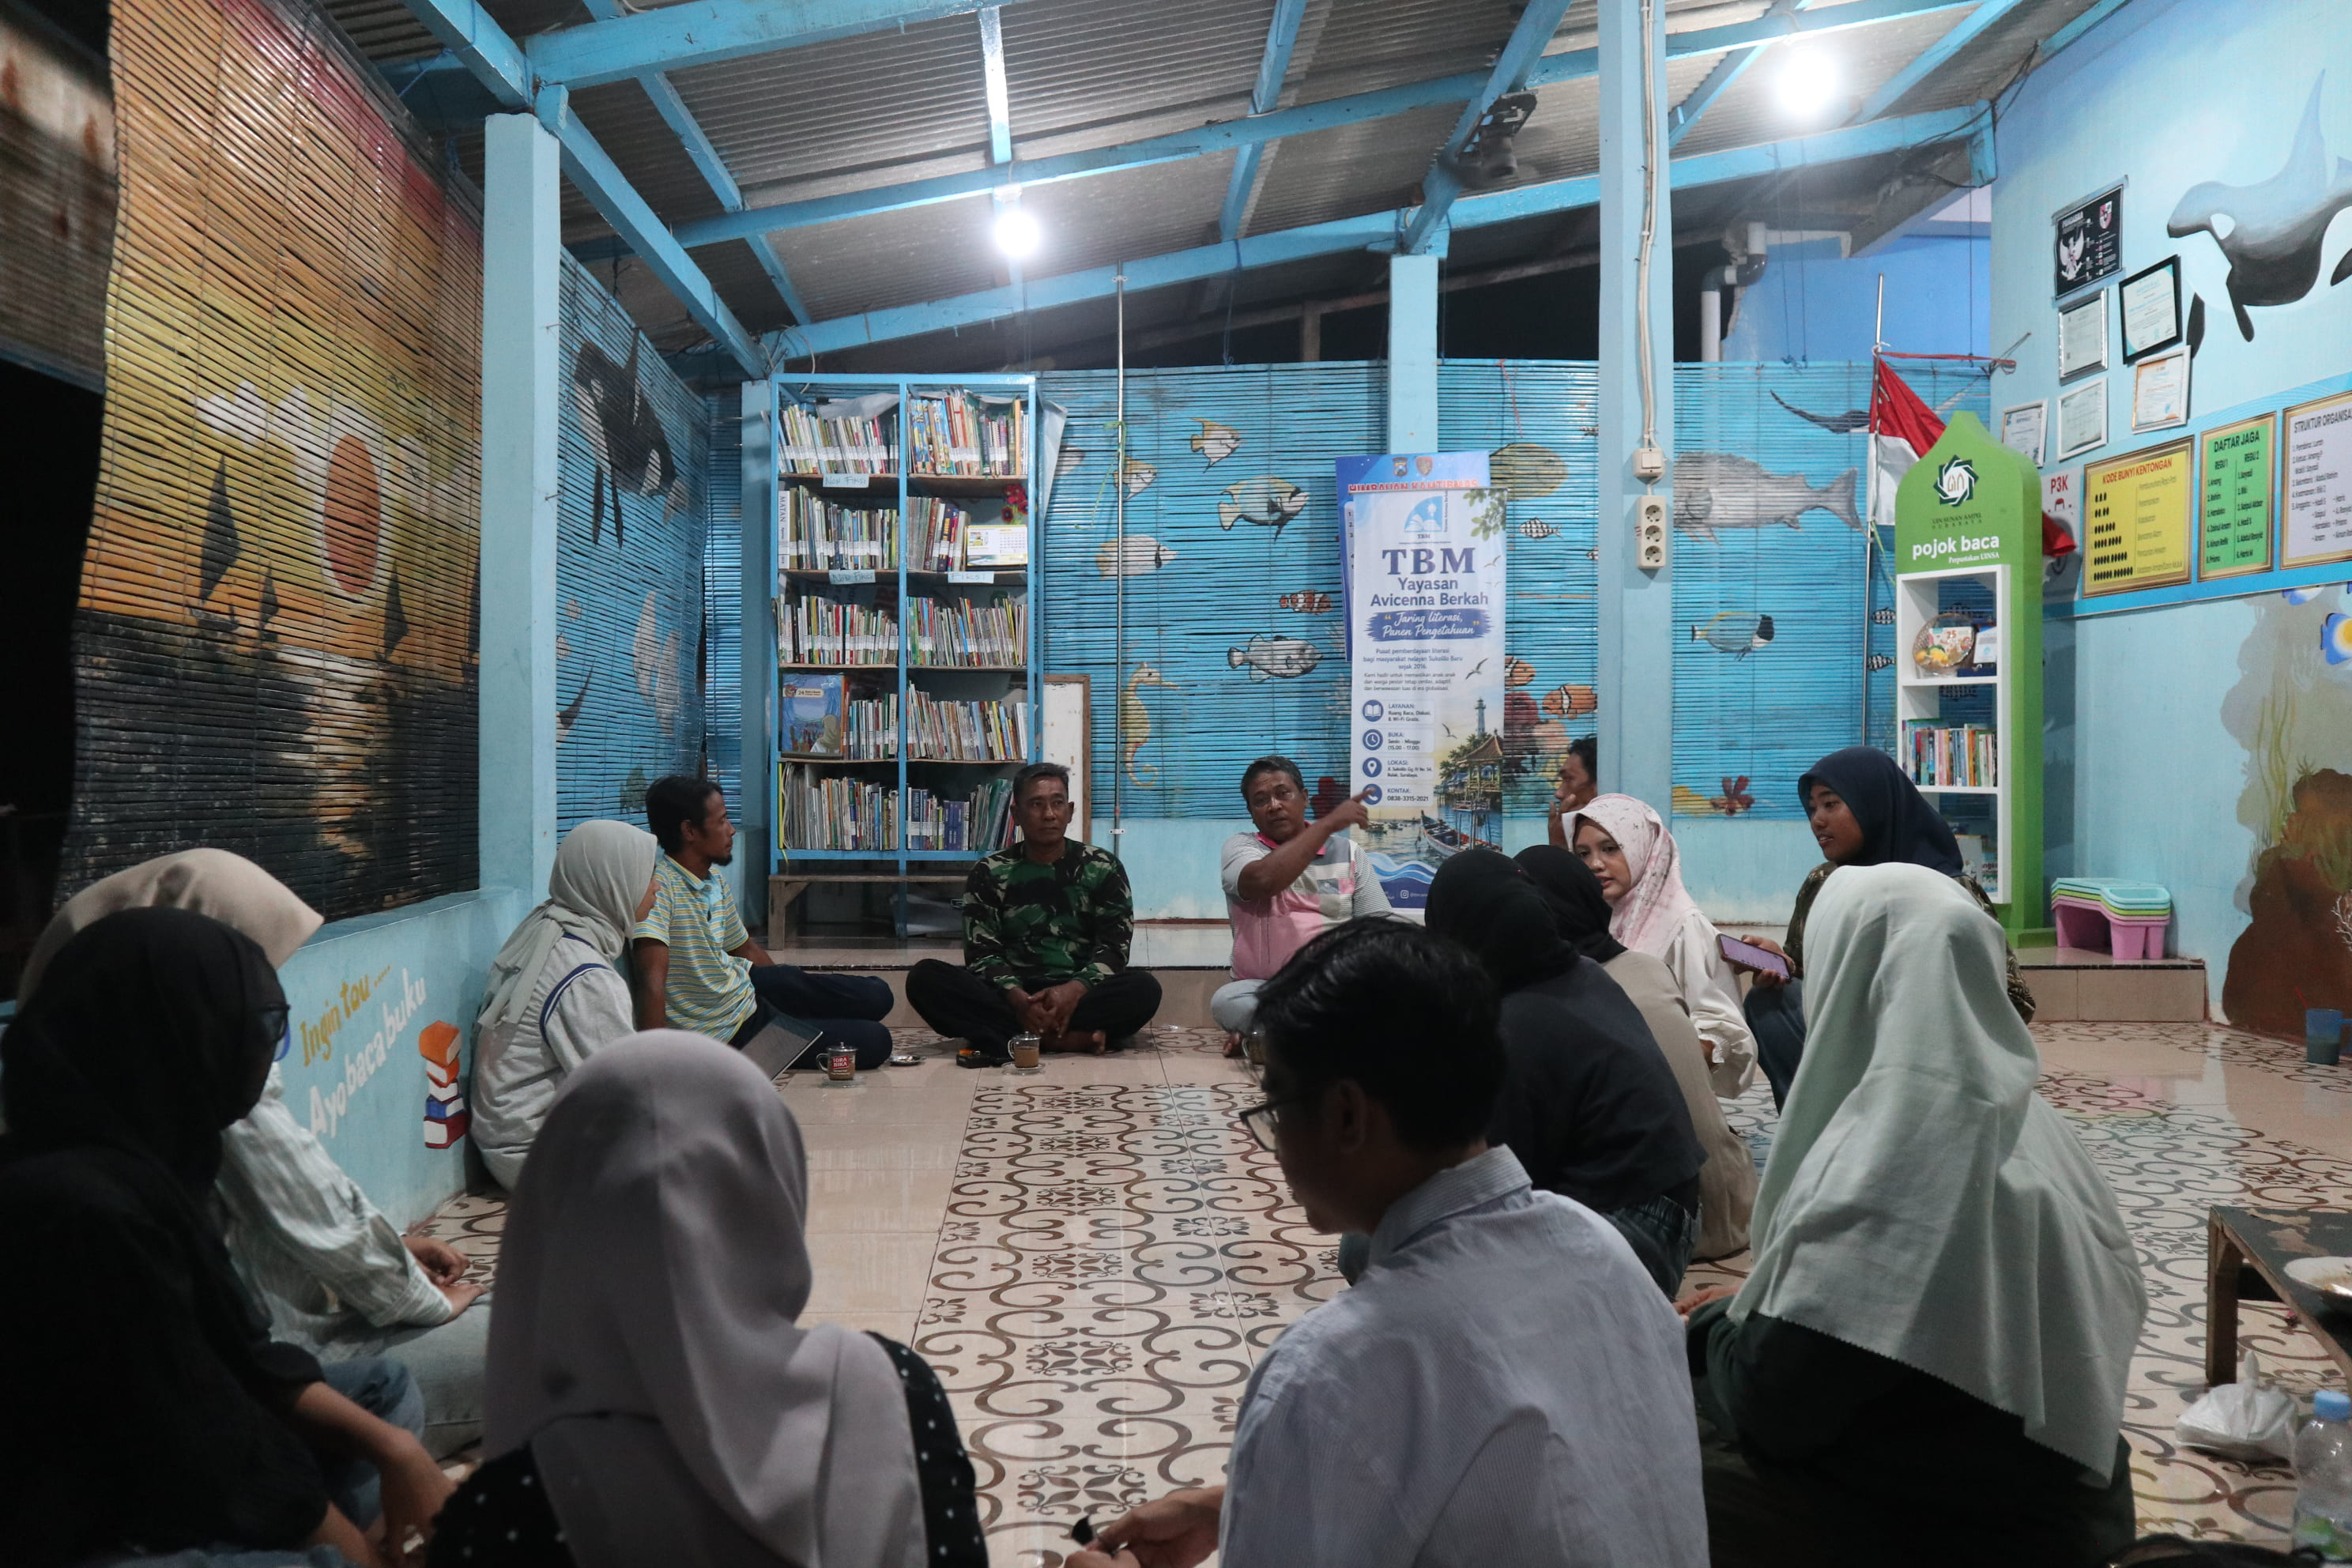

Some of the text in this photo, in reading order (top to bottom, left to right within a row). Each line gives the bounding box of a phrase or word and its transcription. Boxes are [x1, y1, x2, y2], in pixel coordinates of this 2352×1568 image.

[2294, 416, 2322, 433] STRUKTUR
[2214, 431, 2260, 453] DAFTAR JAGA
[2214, 459, 2226, 470] REGU
[2244, 452, 2256, 462] REGU
[2102, 458, 2173, 484] KODE BUNYI KENTONGAN
[2050, 475, 2069, 494] P3K
[1913, 535, 2000, 560] pojok baca
[1381, 547, 1476, 575] TBM
[1398, 578, 1458, 594] Yayasan
[1370, 591, 1488, 607] Avicenna Berkah
[1394, 612, 1426, 627] Jaring
[1382, 624, 1476, 639] Panen Pengetahuan
[300, 999, 341, 1068] Ingin
[310, 967, 427, 1138] Ayo baca buku
